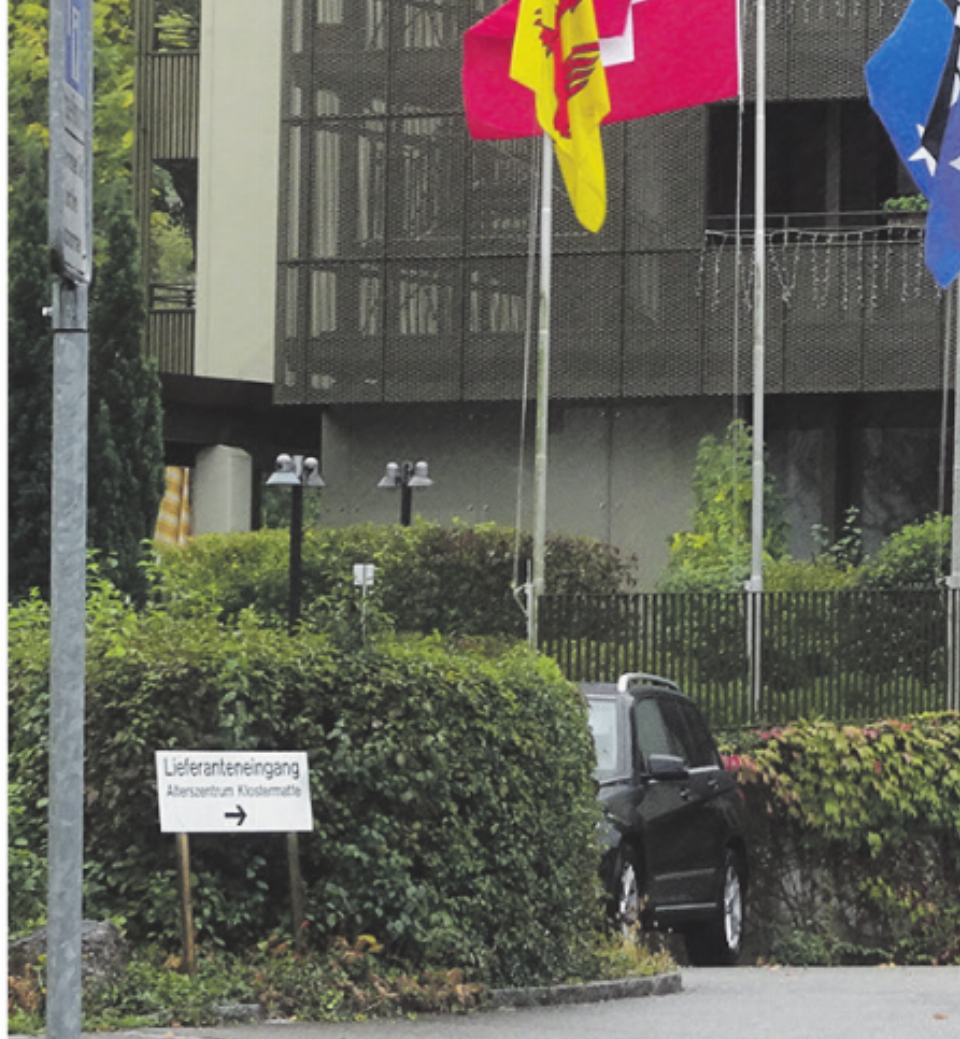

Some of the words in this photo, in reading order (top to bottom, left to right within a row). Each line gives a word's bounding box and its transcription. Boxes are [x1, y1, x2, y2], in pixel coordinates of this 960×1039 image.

[163, 757, 300, 780] Lieferanteneingang
[166, 784, 234, 798] Alterszentrum
[238, 784, 301, 798] Klostermatte
